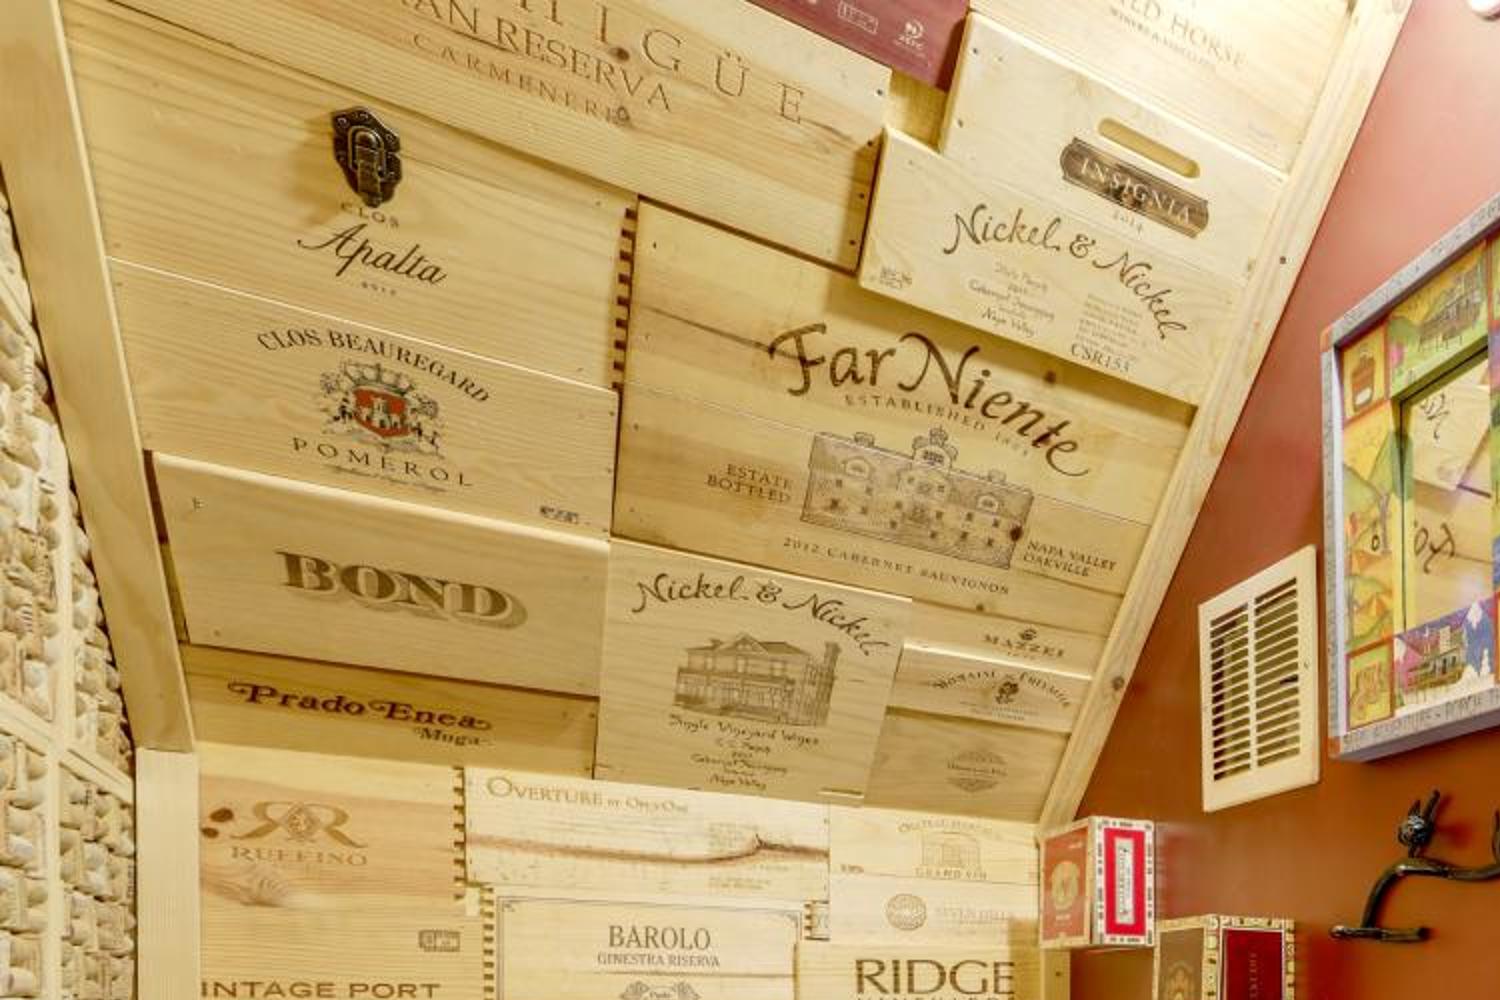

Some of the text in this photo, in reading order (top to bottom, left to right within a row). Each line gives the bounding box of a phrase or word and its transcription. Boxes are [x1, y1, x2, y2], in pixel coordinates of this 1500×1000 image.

[496, 16, 672, 113] RESERVA
[1081, 158, 1190, 224] INSIGNIA
[297, 223, 448, 285] Apalta
[944, 203, 1061, 255] Nickel
[1069, 233, 1096, 259] &
[1091, 251, 1188, 341] Nickel
[256, 328, 491, 404] CLOS BEAUREGARD
[768, 322, 1090, 478] Far Niente
[845, 394, 987, 432] ESTABLISHED
[291, 436, 475, 487] POMEROL
[726, 462, 794, 490] ESTATE
[706, 474, 792, 504] BOTTLED
[826, 545, 914, 577] CABERNET
[919, 567, 1011, 596] SAUVIGNON
[1027, 538, 1118, 572] NAPA VALLEY
[275, 550, 520, 626] BOND
[631, 573, 749, 614] Nickel
[782, 593, 890, 657] Nickel
[227, 682, 492, 731] Prado Enea
[413, 726, 484, 748] Muga
[486, 776, 603, 806] OVERTURE
[230, 846, 368, 867] RUFFINO
[608, 924, 711, 951] BAROLO
[201, 981, 441, 999] INTAGE PORT
[854, 958, 1016, 996] RIDGE
